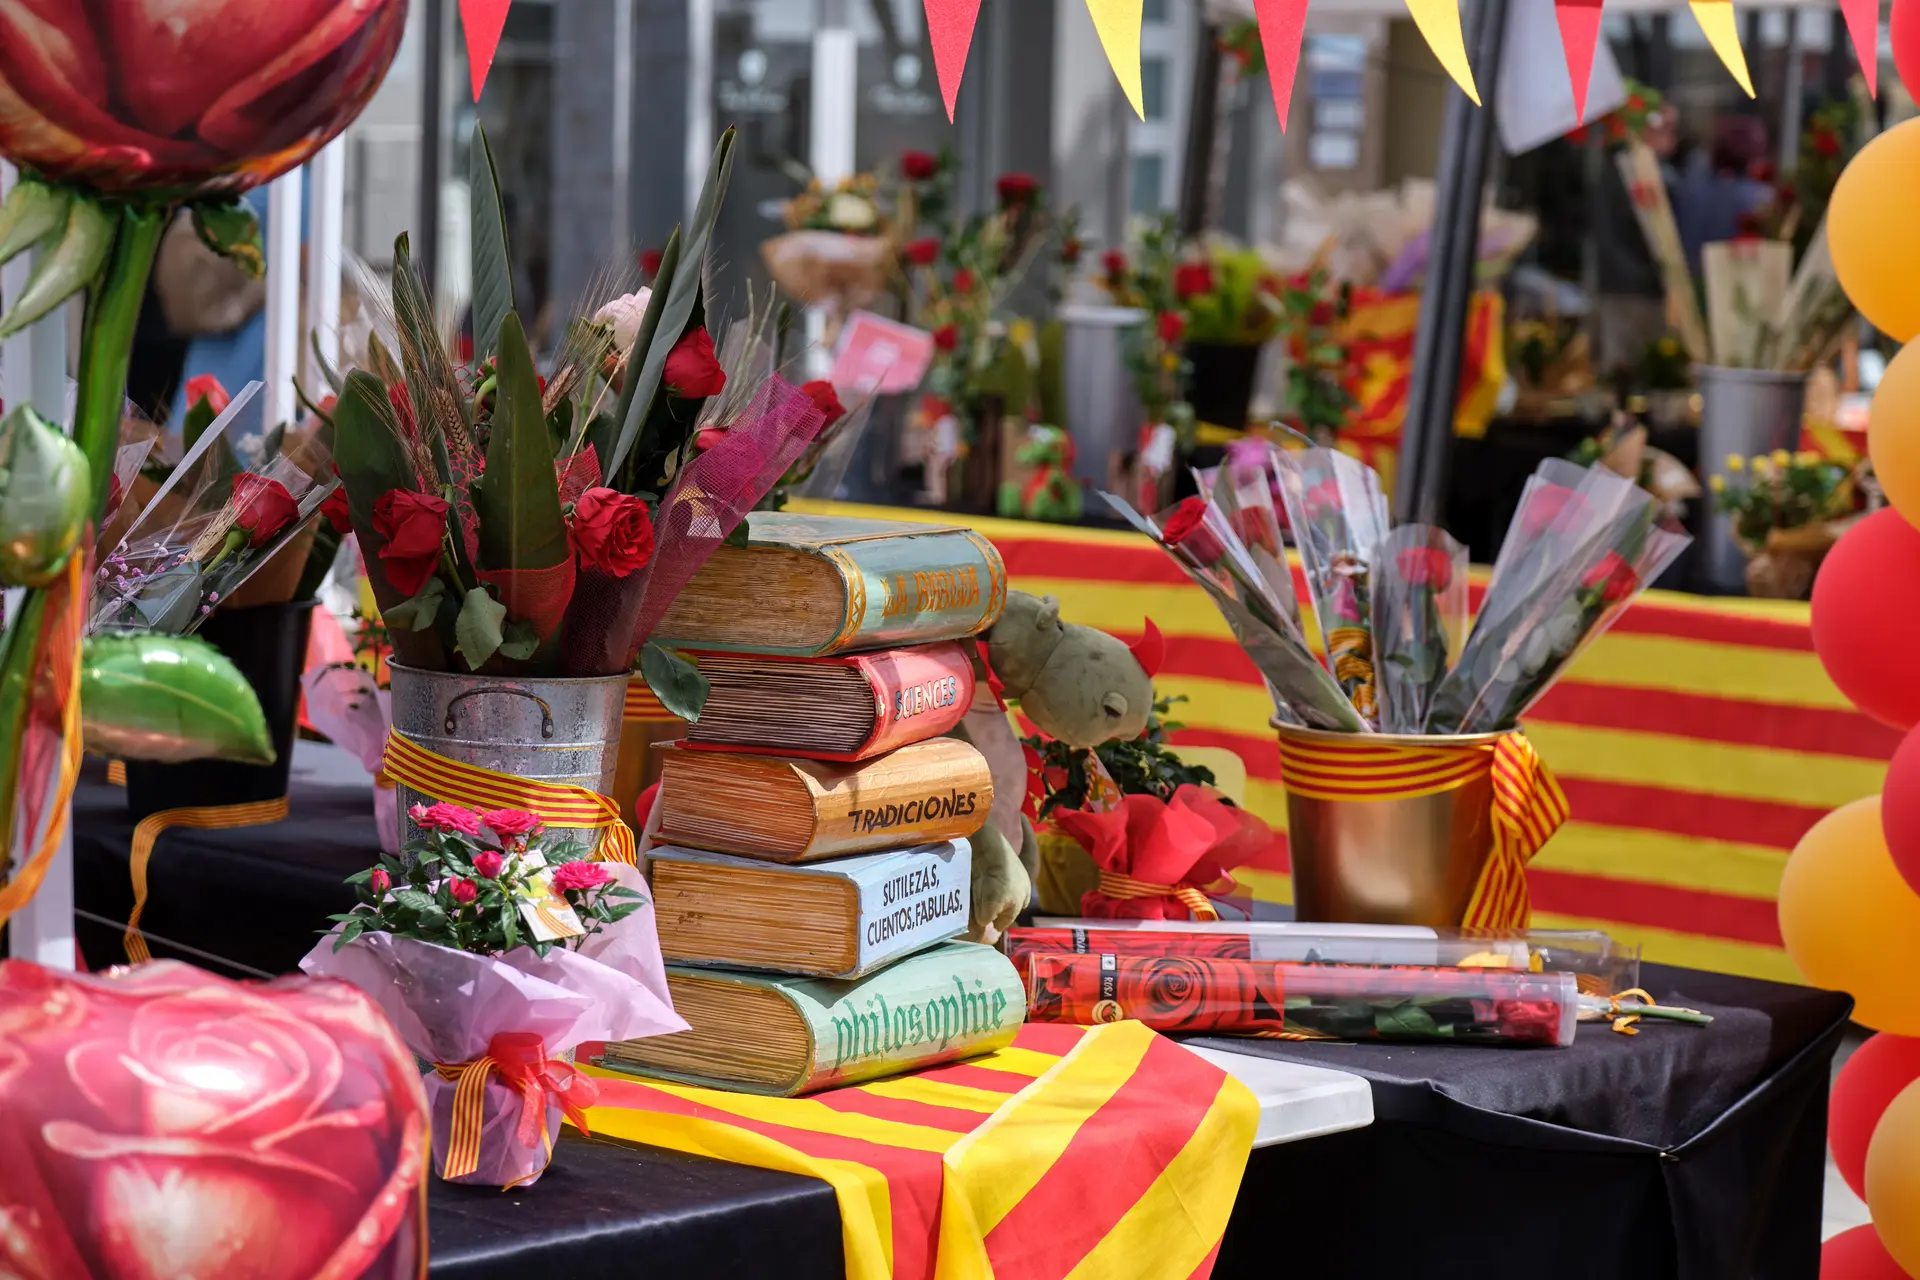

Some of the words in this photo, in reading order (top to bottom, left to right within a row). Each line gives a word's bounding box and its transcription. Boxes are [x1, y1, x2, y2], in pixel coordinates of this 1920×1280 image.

[879, 576, 908, 617] LA
[912, 567, 980, 612] BIBLIA
[893, 675, 957, 722] SCIENCES
[848, 788, 977, 834] TRADICIONES
[883, 863, 940, 907] SUTILEZAS,
[867, 906, 915, 947] CUENTOS,
[1103, 976, 1114, 997] ROSA
[831, 974, 1007, 1077] philosophie
